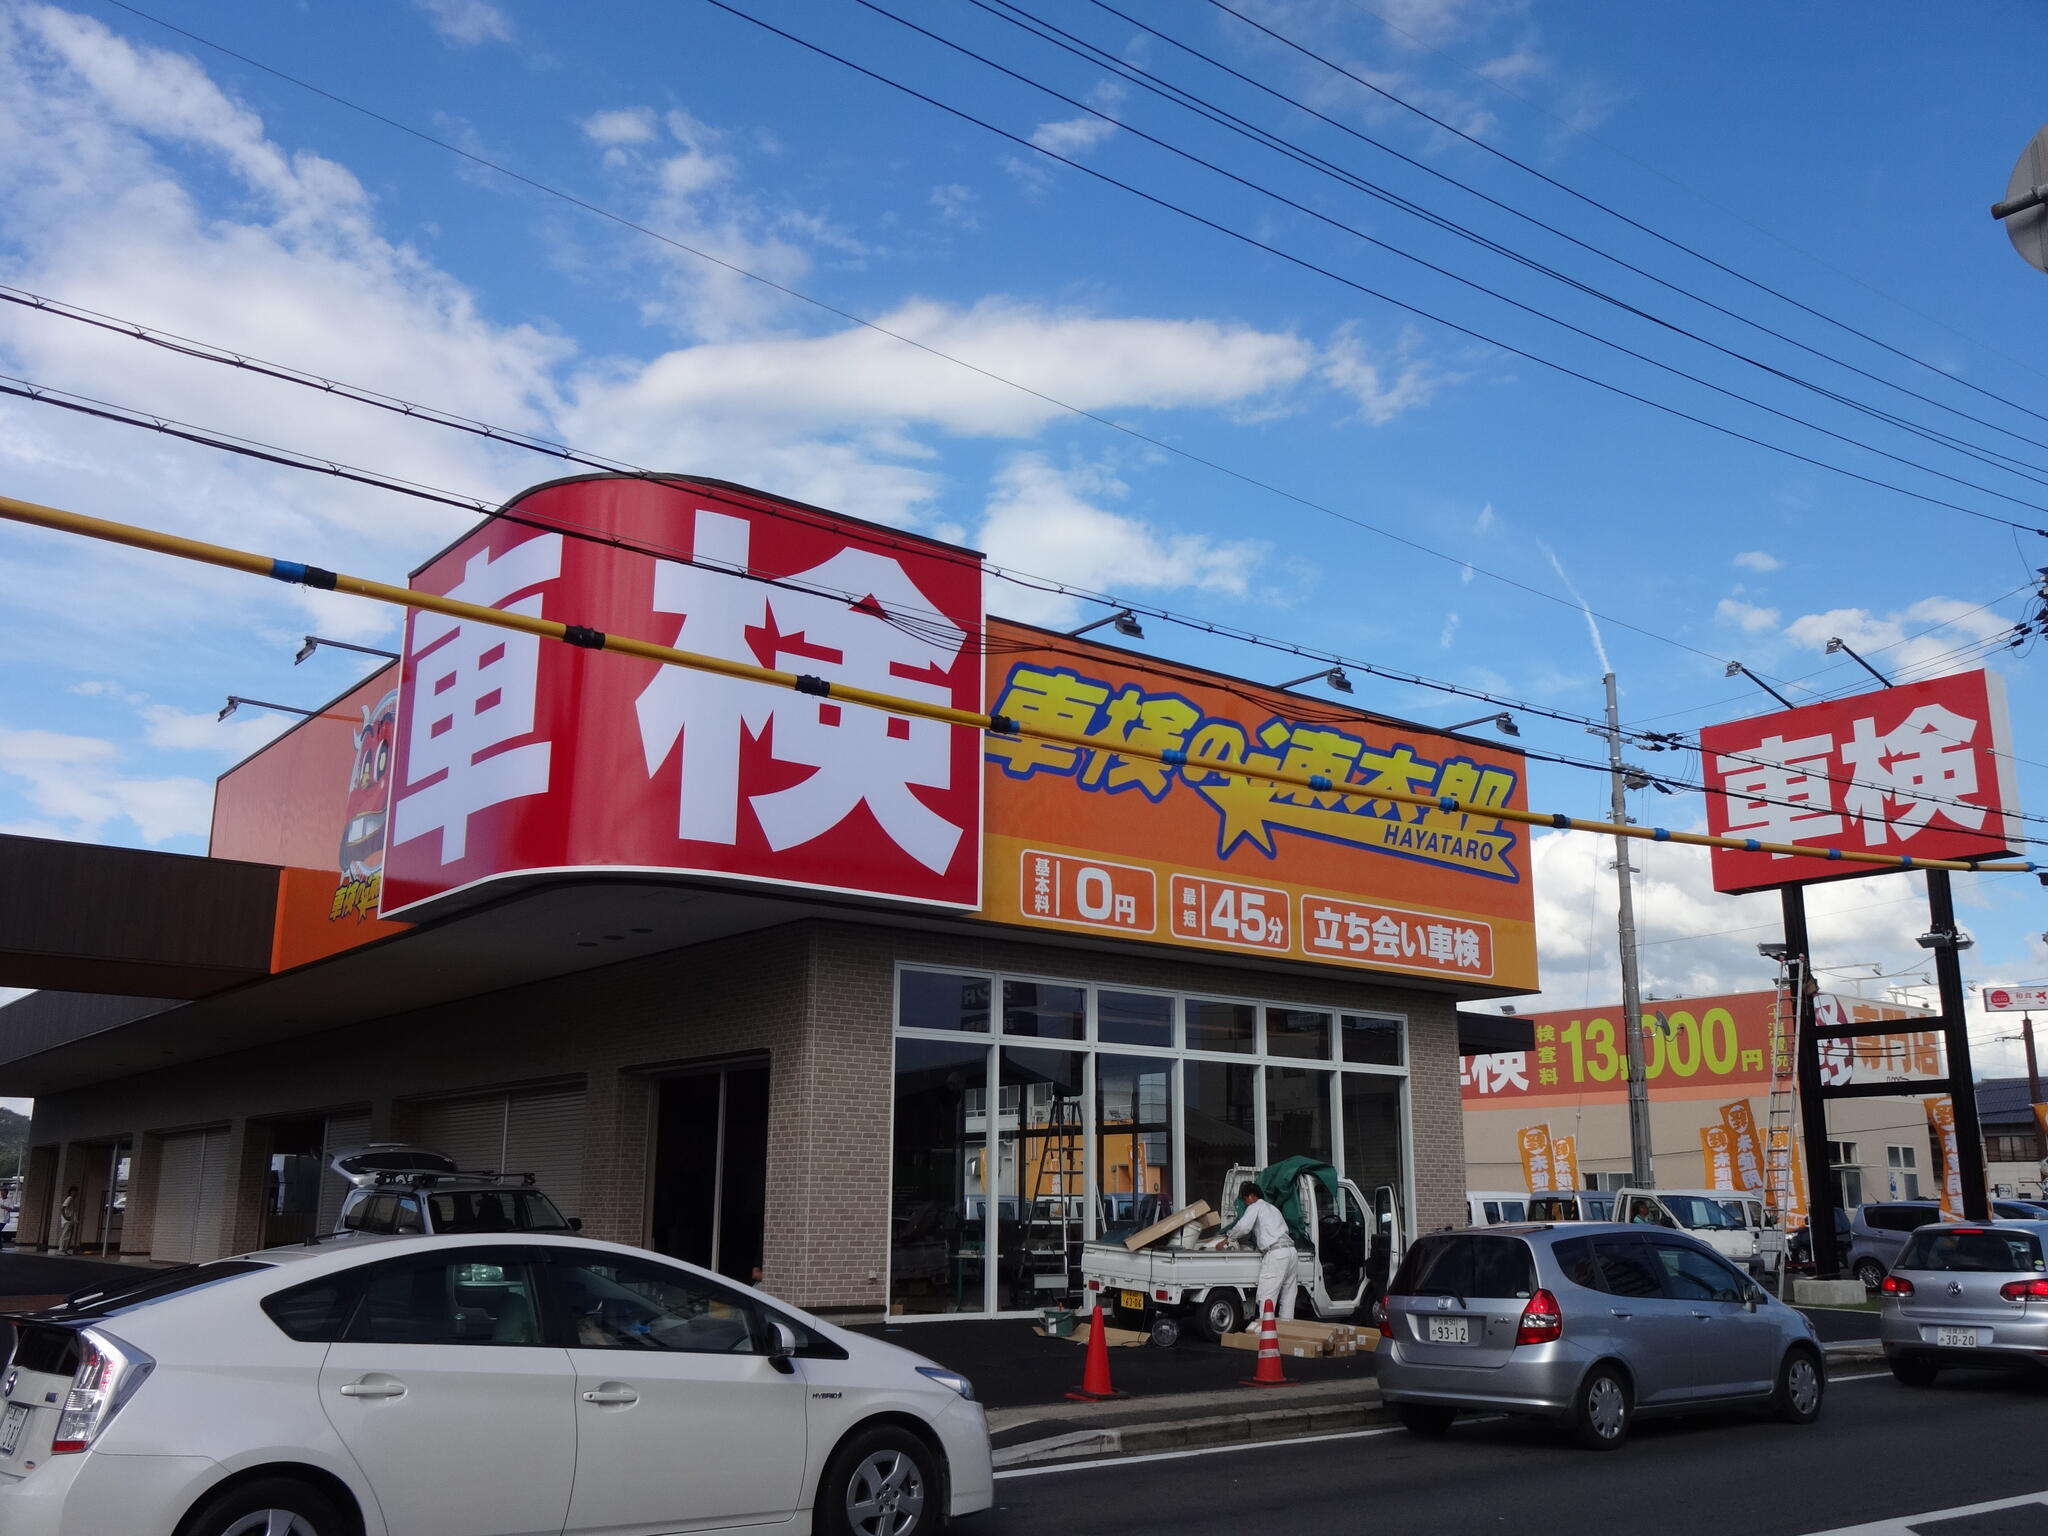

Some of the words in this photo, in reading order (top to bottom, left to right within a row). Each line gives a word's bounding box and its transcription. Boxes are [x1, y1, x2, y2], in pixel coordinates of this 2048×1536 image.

[393, 509, 968, 876] 車検
[1716, 703, 1988, 860] 車検
[1384, 824, 1493, 862] HAYATARO
[1034, 857, 1050, 914] 基本料
[1076, 866, 1136, 924] 0円
[1183, 887, 1196, 928] 最短
[1210, 889, 1284, 944] 45分
[1313, 906, 1481, 969] 立ち会い車検
[1536, 1024, 1559, 1086] 検査料
[1437, 1326, 1466, 1341] 93-12
